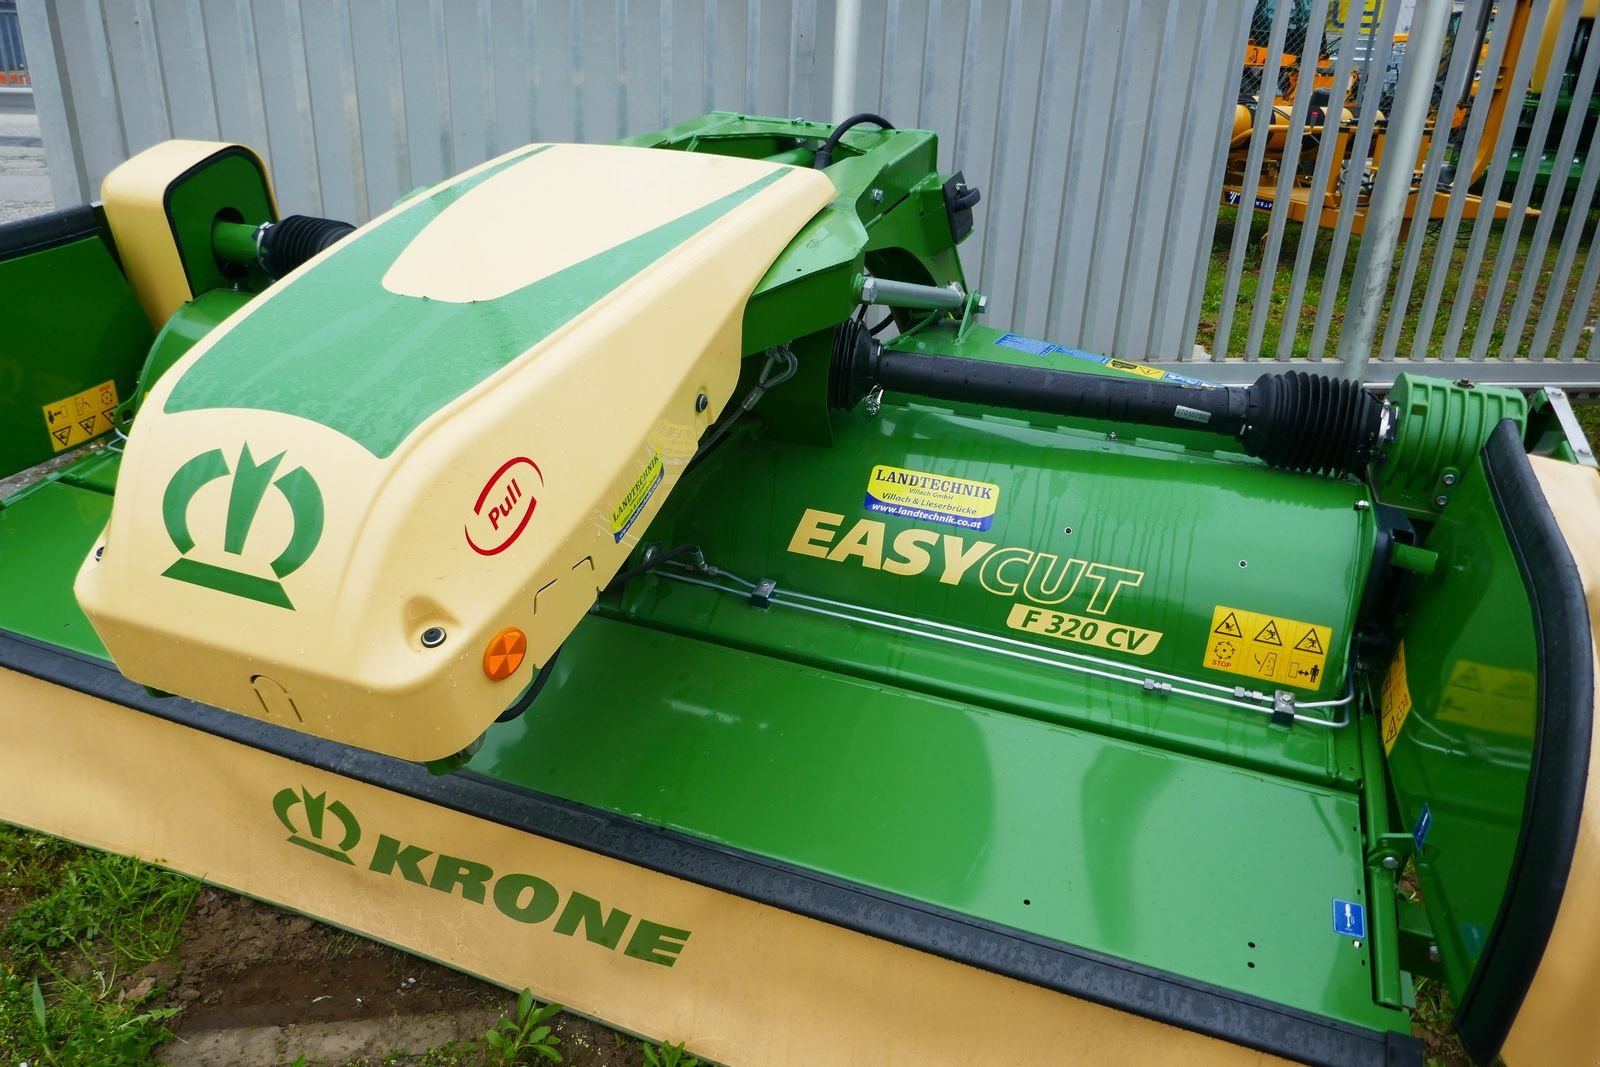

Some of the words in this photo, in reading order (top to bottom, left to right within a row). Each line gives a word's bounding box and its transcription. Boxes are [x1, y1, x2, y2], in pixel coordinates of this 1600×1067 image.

[613, 453, 659, 522] LANDTECHNIK
[876, 469, 993, 500] LANDTECHNIK
[909, 488, 931, 497] Villach
[932, 492, 954, 501] GmbH
[488, 478, 522, 531] Pull
[872, 503, 982, 529] www.landtechnik.co.at
[882, 492, 910, 504] Villach
[912, 497, 920, 505] &
[921, 499, 977, 515] Lieserbrücke
[1021, 609, 1043, 628] F
[1045, 614, 1099, 641] 320
[1105, 627, 1150, 651] CV
[1211, 659, 1232, 668] STOP
[369, 833, 692, 968] KRONE
